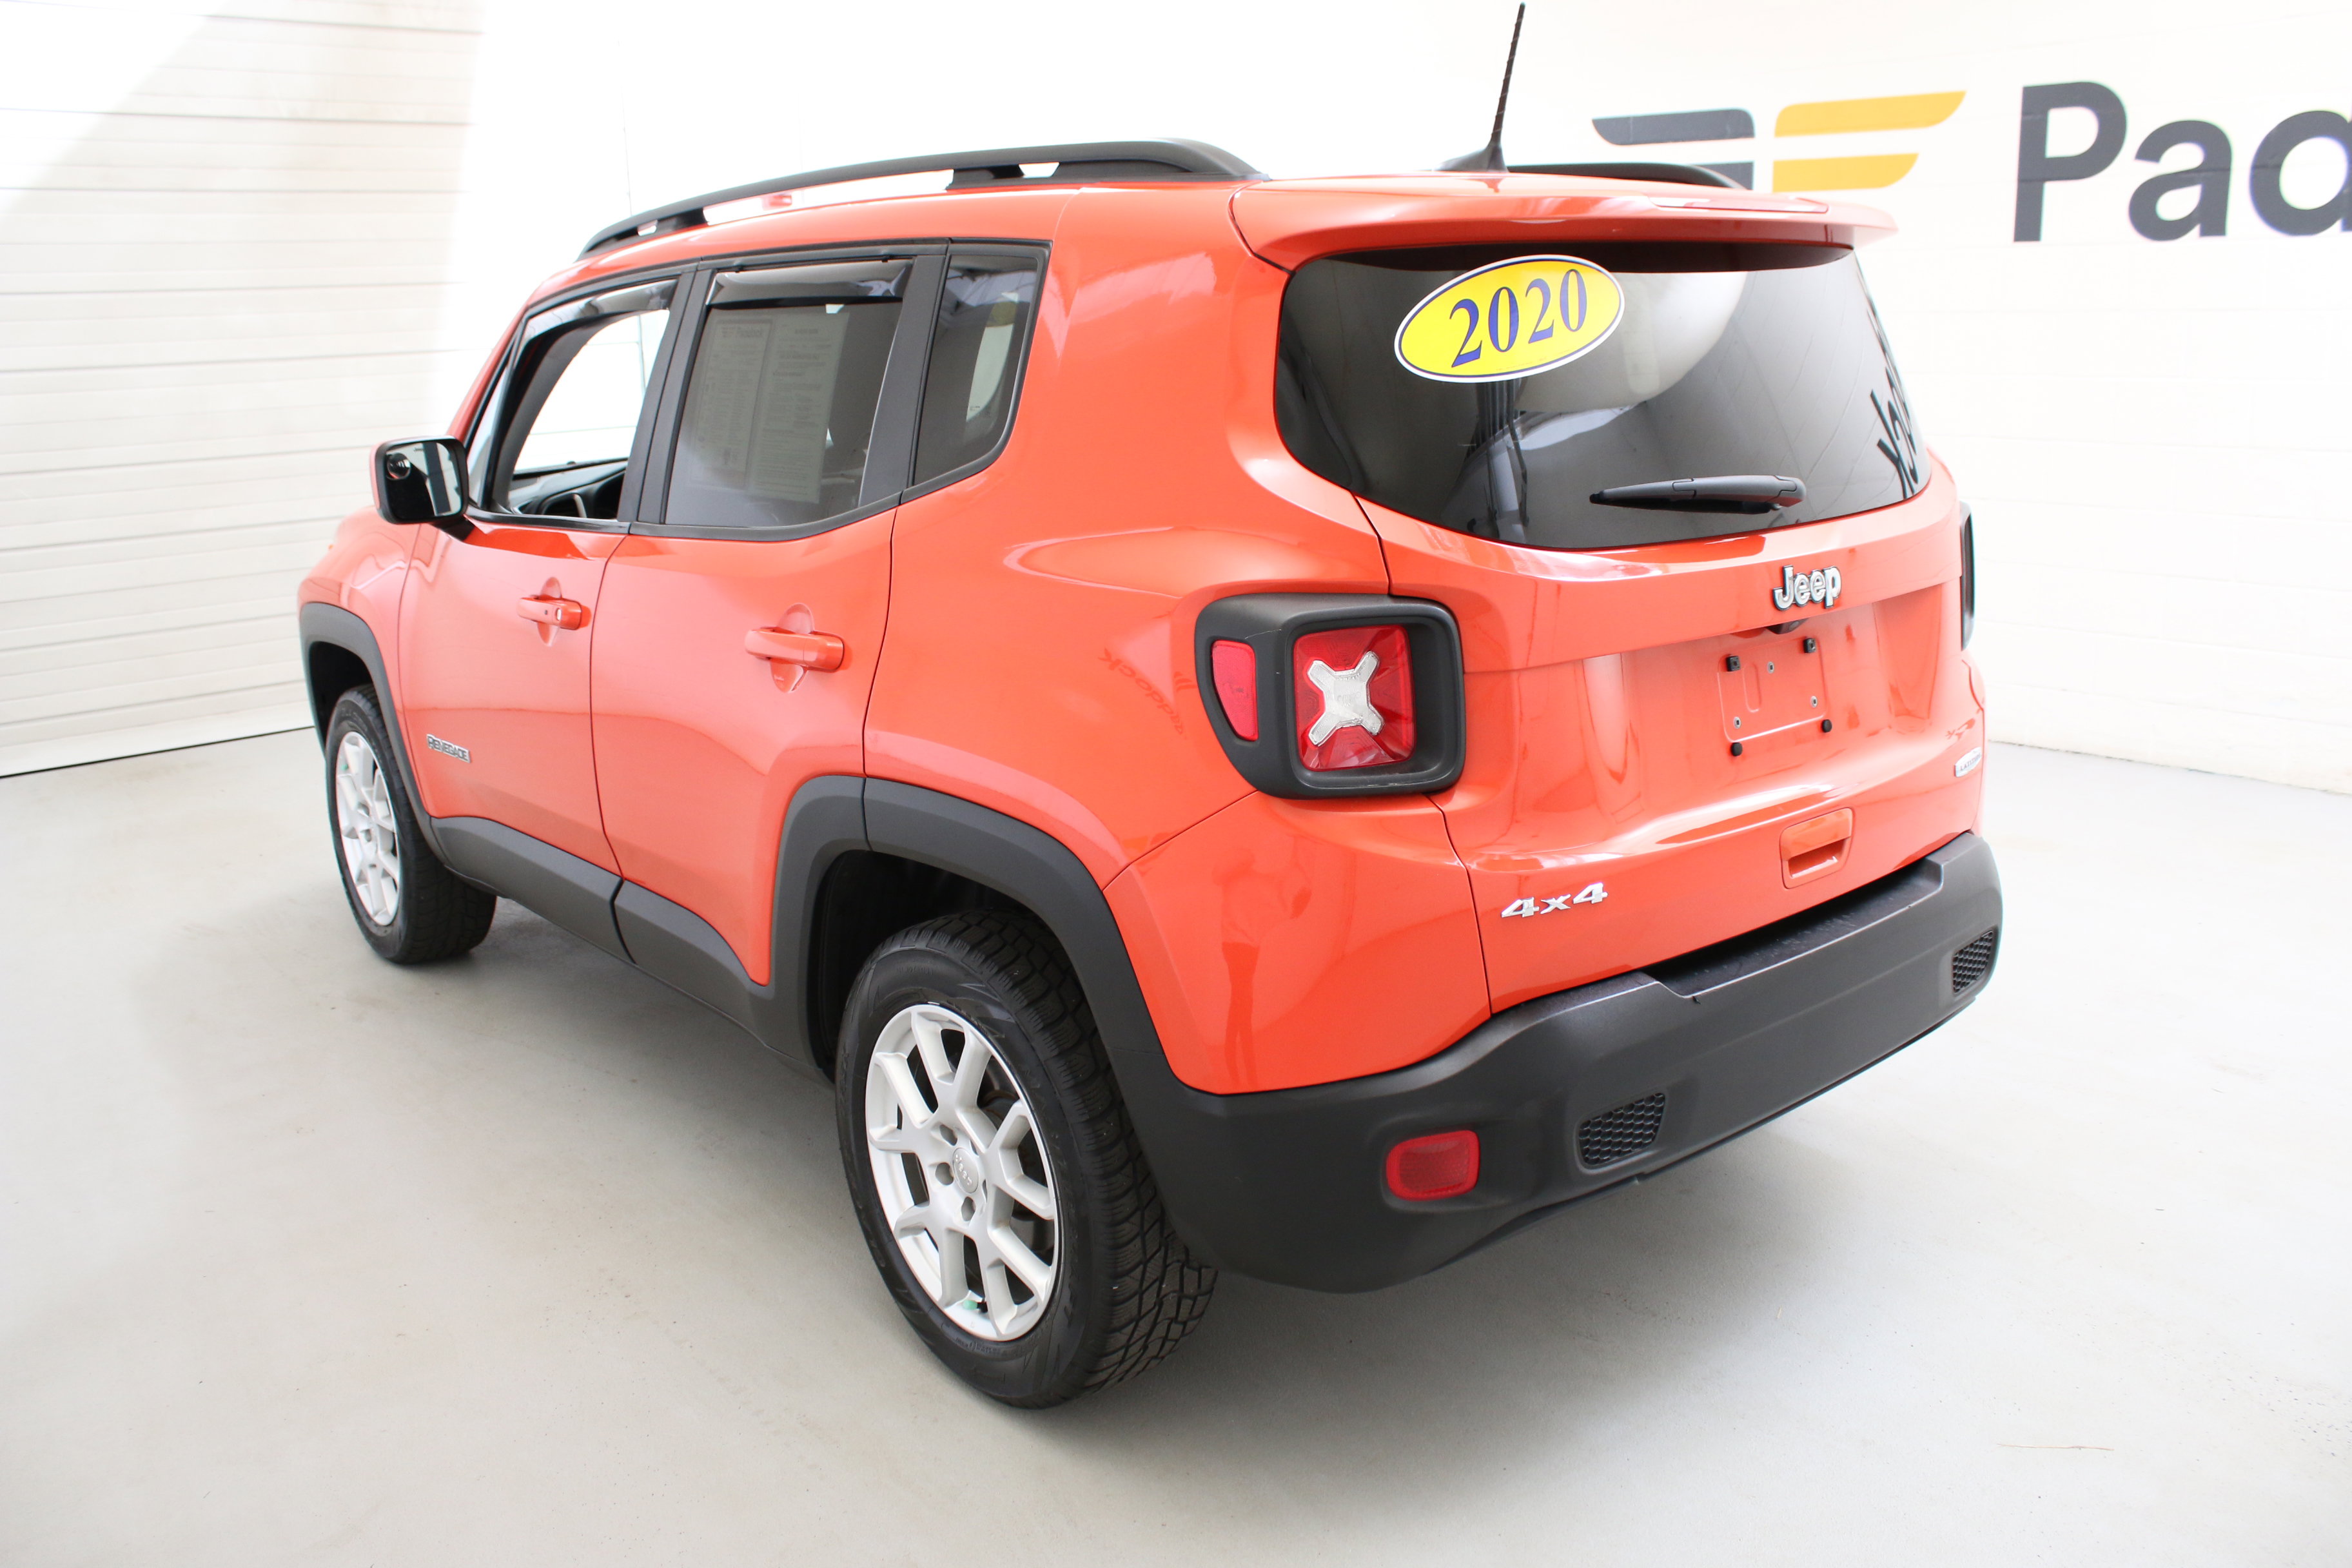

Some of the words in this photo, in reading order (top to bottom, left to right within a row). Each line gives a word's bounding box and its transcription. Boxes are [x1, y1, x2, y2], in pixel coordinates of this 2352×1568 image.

[1449, 268, 1587, 368] 2020
[1772, 565, 1842, 611] Jeep
[426, 733, 471, 763] RENEGADE
[1501, 881, 1608, 918] 4x4
[956, 1153, 972, 1186] Jeep
